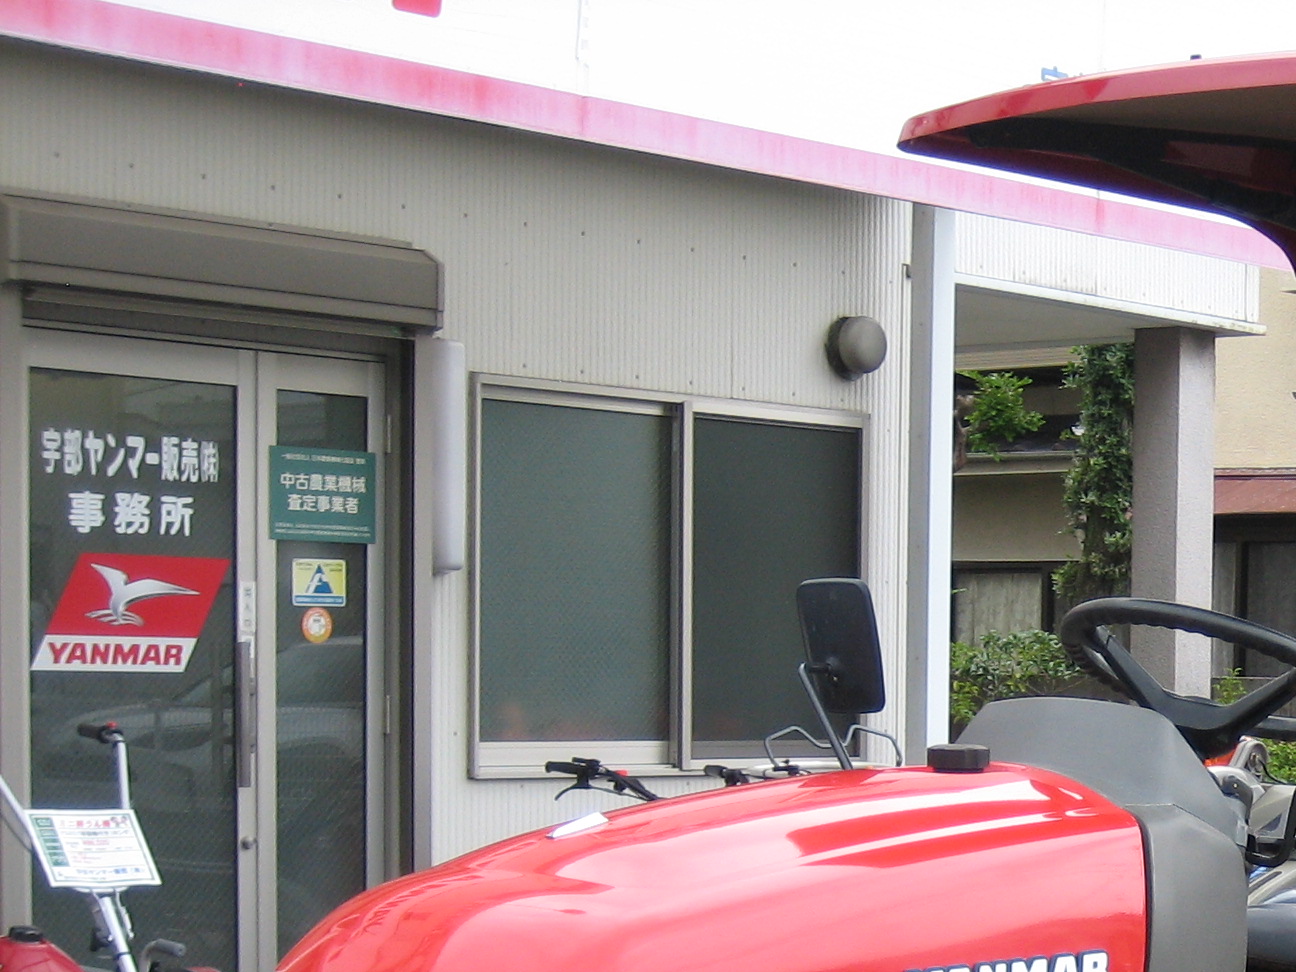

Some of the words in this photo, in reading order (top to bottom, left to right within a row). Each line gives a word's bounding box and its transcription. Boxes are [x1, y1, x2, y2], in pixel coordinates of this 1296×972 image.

[280, 472, 367, 493] 中古農業機械
[68, 490, 195, 537] 事務所
[287, 494, 360, 514] 査定事業者
[47, 640, 183, 667] YANMAR
